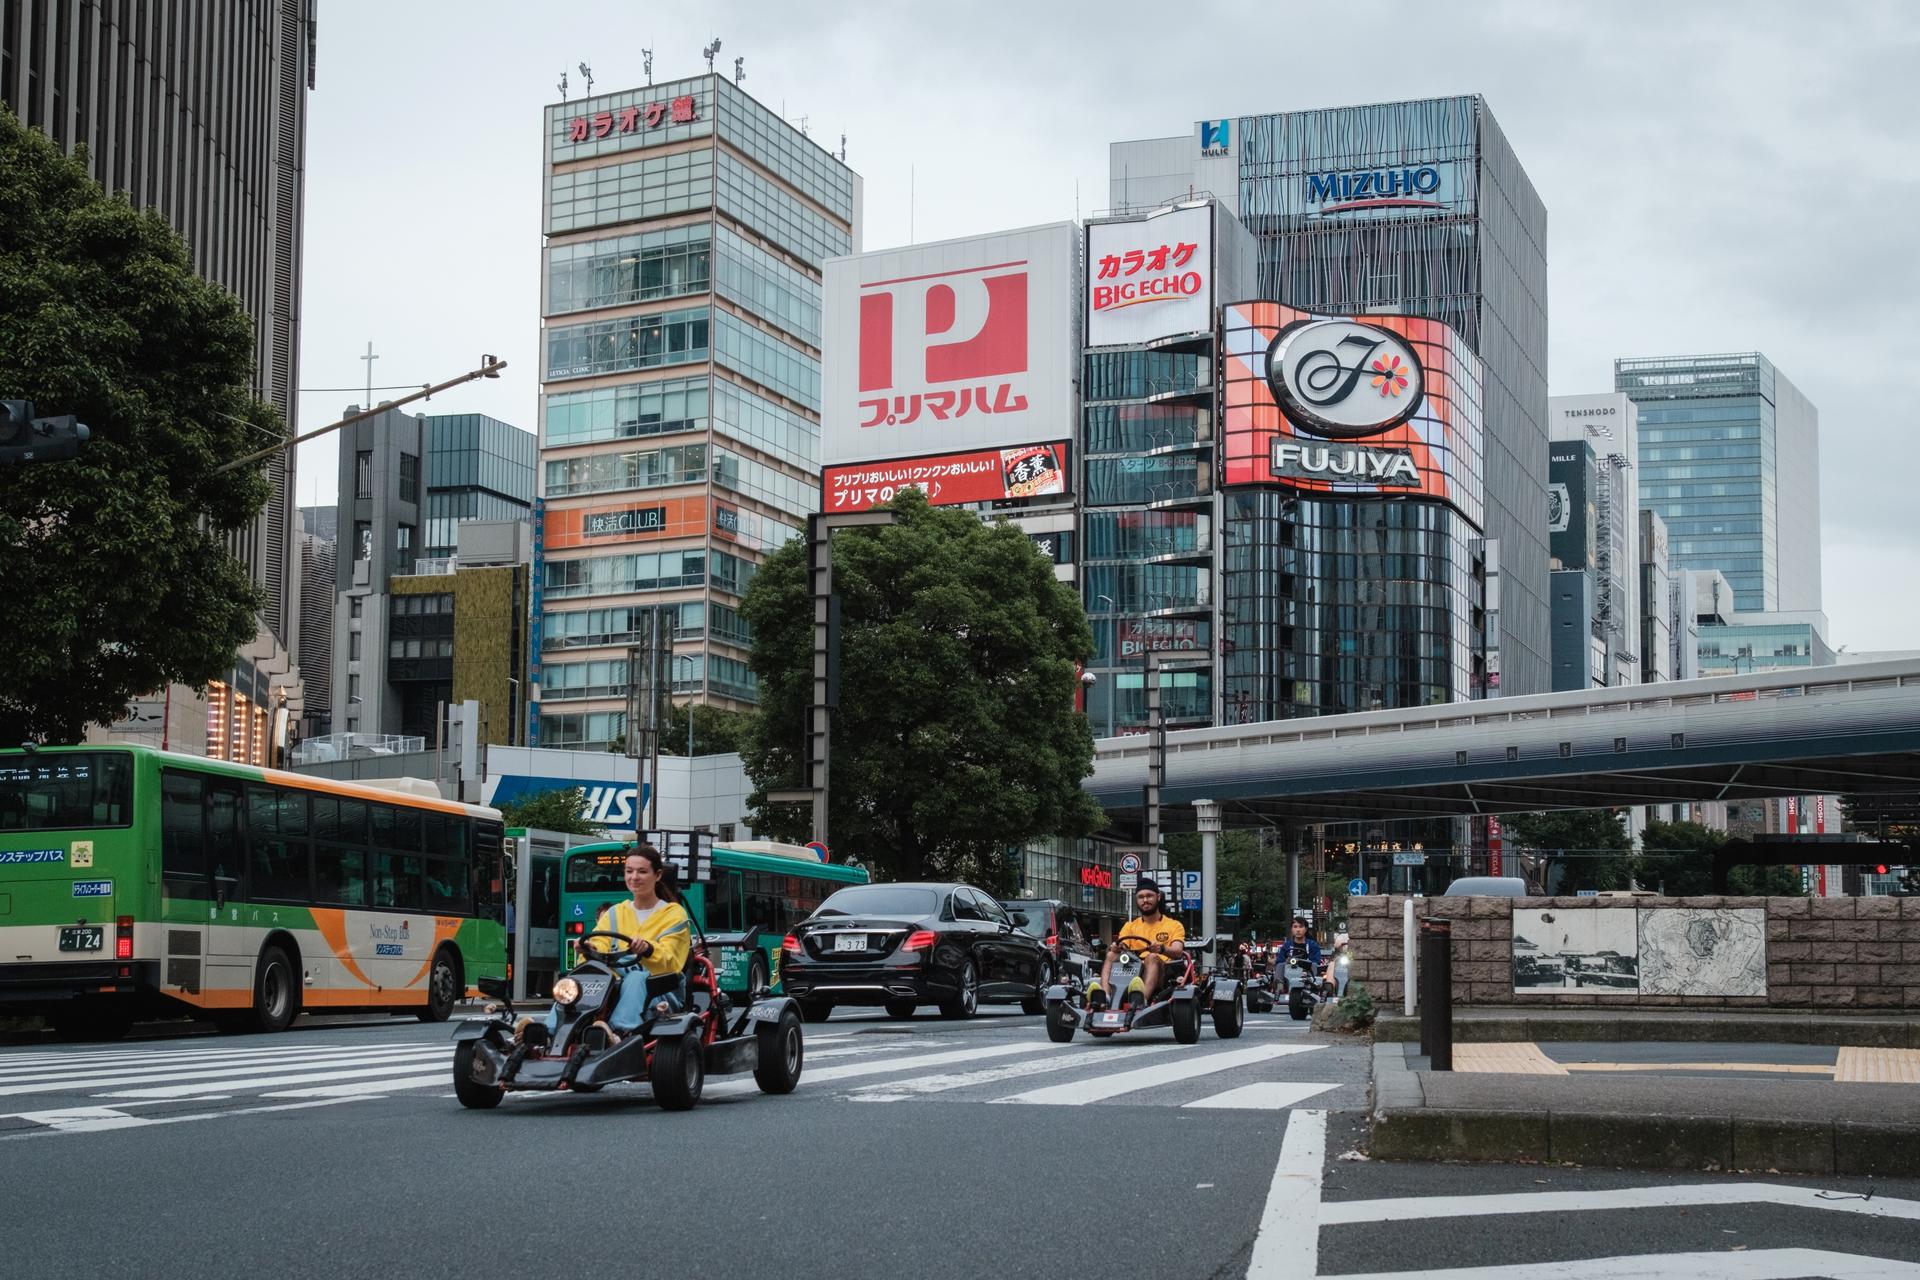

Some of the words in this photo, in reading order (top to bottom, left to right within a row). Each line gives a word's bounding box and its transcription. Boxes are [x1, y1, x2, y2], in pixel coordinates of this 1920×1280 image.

[1202, 148, 1229, 157] HULIC
[1308, 167, 1440, 204] MIZUHO
[1098, 242, 1198, 281] カラオケ
[1094, 283, 1136, 311] BIG
[1140, 271, 1202, 296] ECHO
[858, 383, 1029, 428] プリマハム
[1565, 408, 1616, 418] TENSHODO
[1272, 444, 1420, 481] FUJIYA
[1551, 454, 1576, 463] MILLE
[591, 512, 658, 533] 快活CLUB
[1186, 874, 1198, 889] P
[369, 923, 398, 942] Non-Step
[399, 925, 410, 940] Bus
